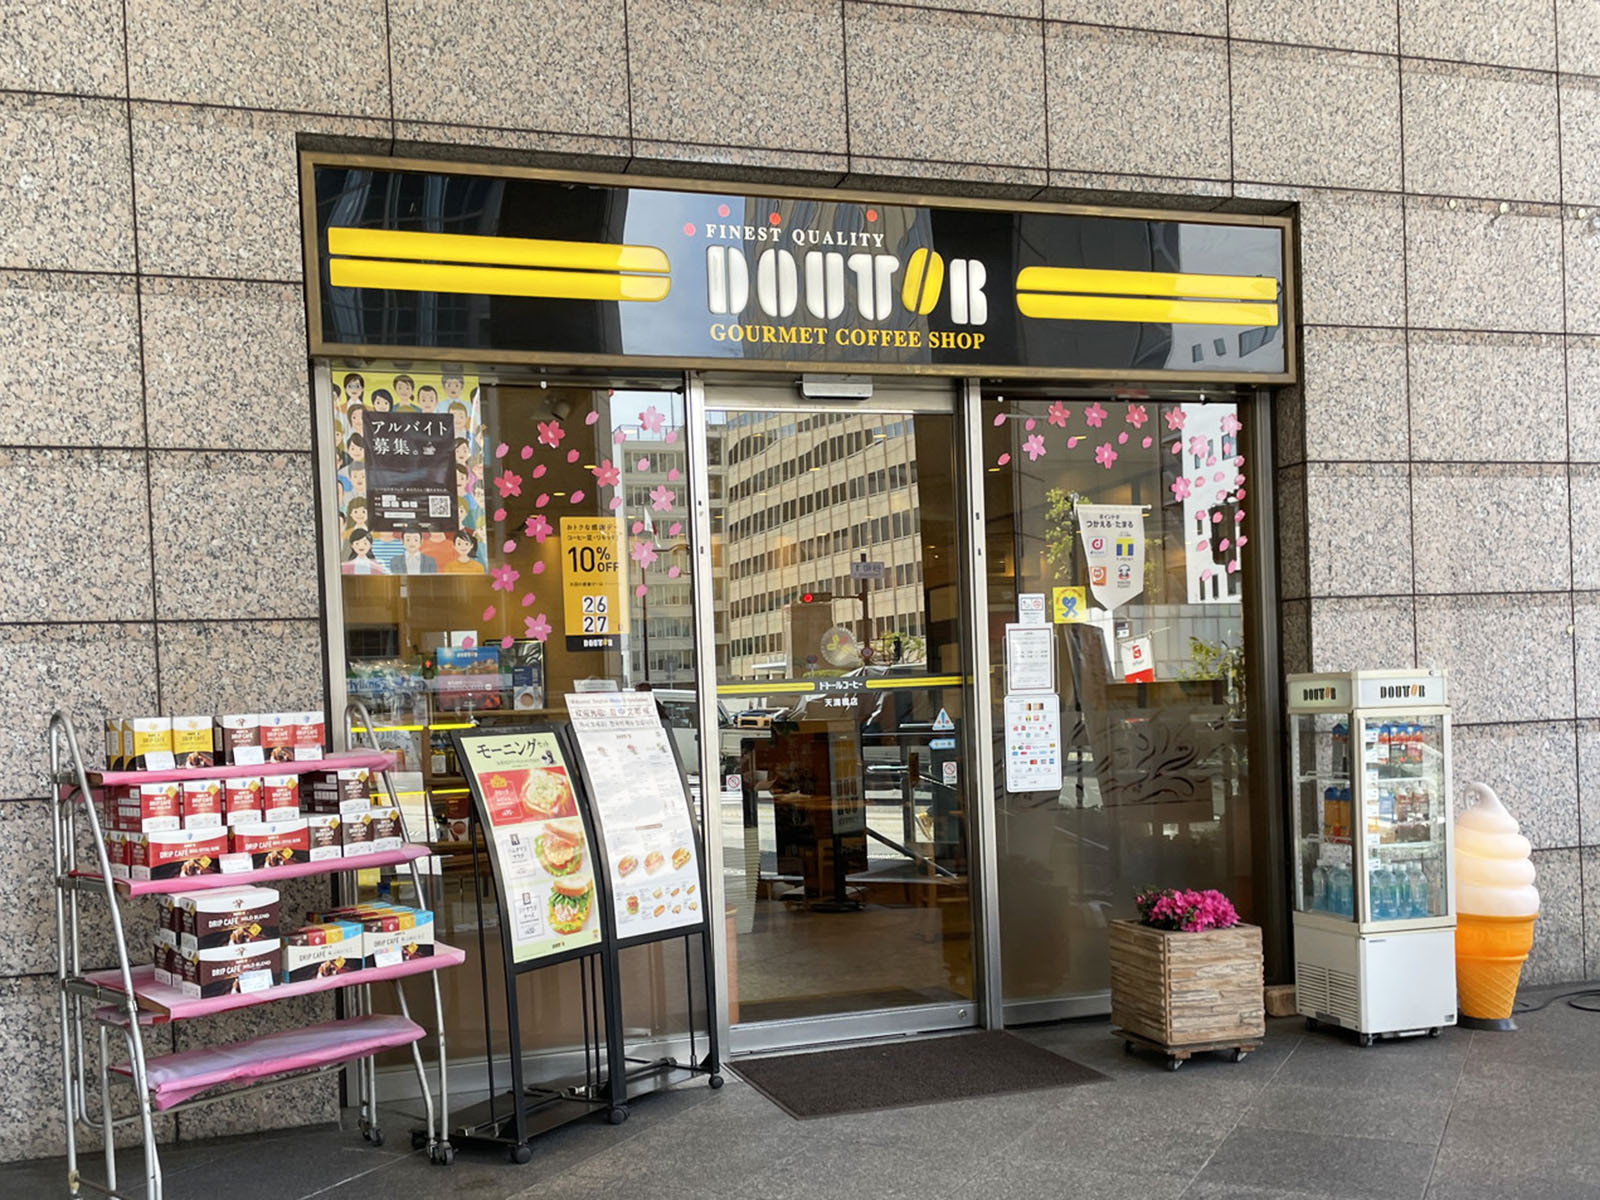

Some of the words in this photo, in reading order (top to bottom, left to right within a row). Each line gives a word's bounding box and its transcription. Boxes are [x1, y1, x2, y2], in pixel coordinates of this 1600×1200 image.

[705, 224, 782, 242] FINEST
[791, 228, 885, 248] QUALITY
[706, 245, 988, 326] DOUTOR
[710, 324, 828, 345] GOURMET
[835, 328, 922, 348] COFFEE
[928, 331, 986, 350] SHOP
[371, 420, 448, 436] アルバイト
[597, 562, 619, 573] OFF
[583, 596, 607, 613] 26
[584, 616, 607, 632] 27
[819, 681, 863, 690] ドトールコーヒー
[1303, 686, 1337, 701] DOUTOR
[1380, 684, 1426, 698] DOUTOR
[476, 738, 537, 759] モーニング
